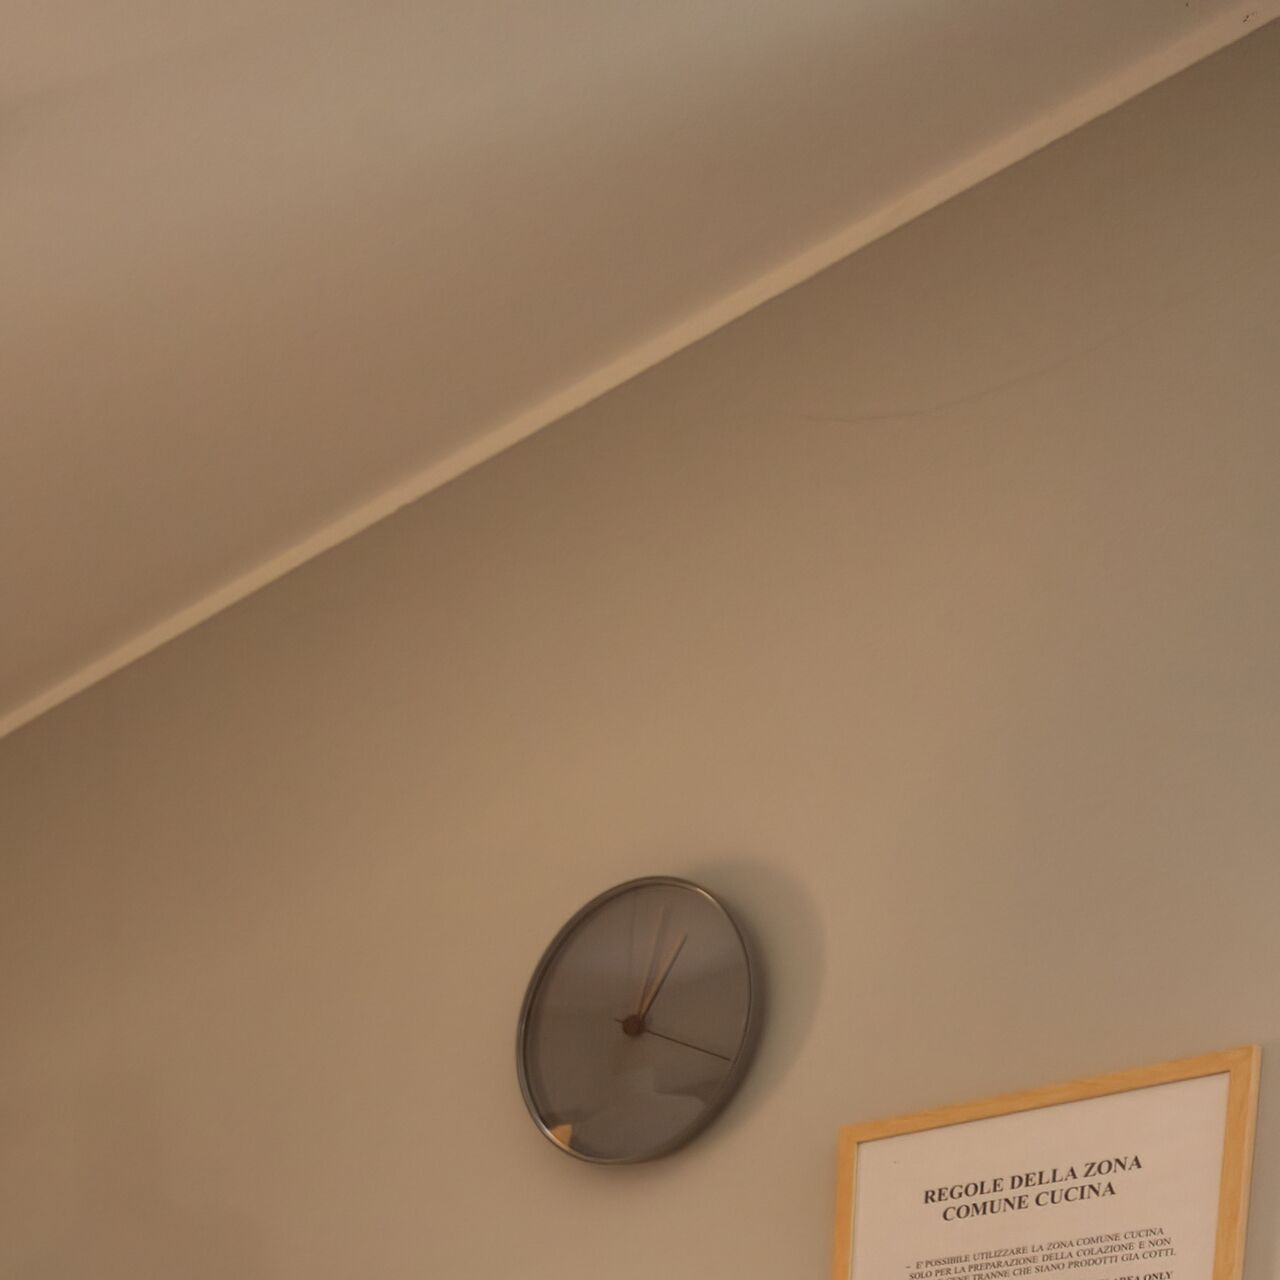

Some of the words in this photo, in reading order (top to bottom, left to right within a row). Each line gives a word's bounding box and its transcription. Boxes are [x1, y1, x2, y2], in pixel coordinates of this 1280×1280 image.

[924, 1177, 1003, 1204] REGOLE
[1010, 1165, 1078, 1190] DELLA
[1083, 1154, 1142, 1178] ZONA
[942, 1194, 1029, 1221] COMUNE
[1034, 1181, 1116, 1207] CUCINA
[909, 1270, 932, 1280] SOLO
[935, 1268, 951, 1276] PER
[954, 1266, 965, 1274] LA
[968, 1256, 1038, 1272] PREPARAZIONE
[1042, 1251, 1073, 1262] DELLA
[1076, 1242, 1134, 1257] COLAZIONE
[1138, 1241, 1145, 1249] E
[1148, 1237, 1171, 1248] NON
[973, 1246, 1027, 1260] UTILIZZARE
[1031, 1244, 1043, 1252] LA
[1046, 1240, 1073, 1250] ZONA
[1075, 1233, 1120, 1246] COMUNE
[1123, 1227, 1164, 1240] CUCINA
[972, 1270, 1009, 1280] TRANNE
[1012, 1267, 1031, 1276] CHE
[1034, 1262, 1064, 1273] SIANO
[1067, 1255, 1118, 1269] PRODOTTI
